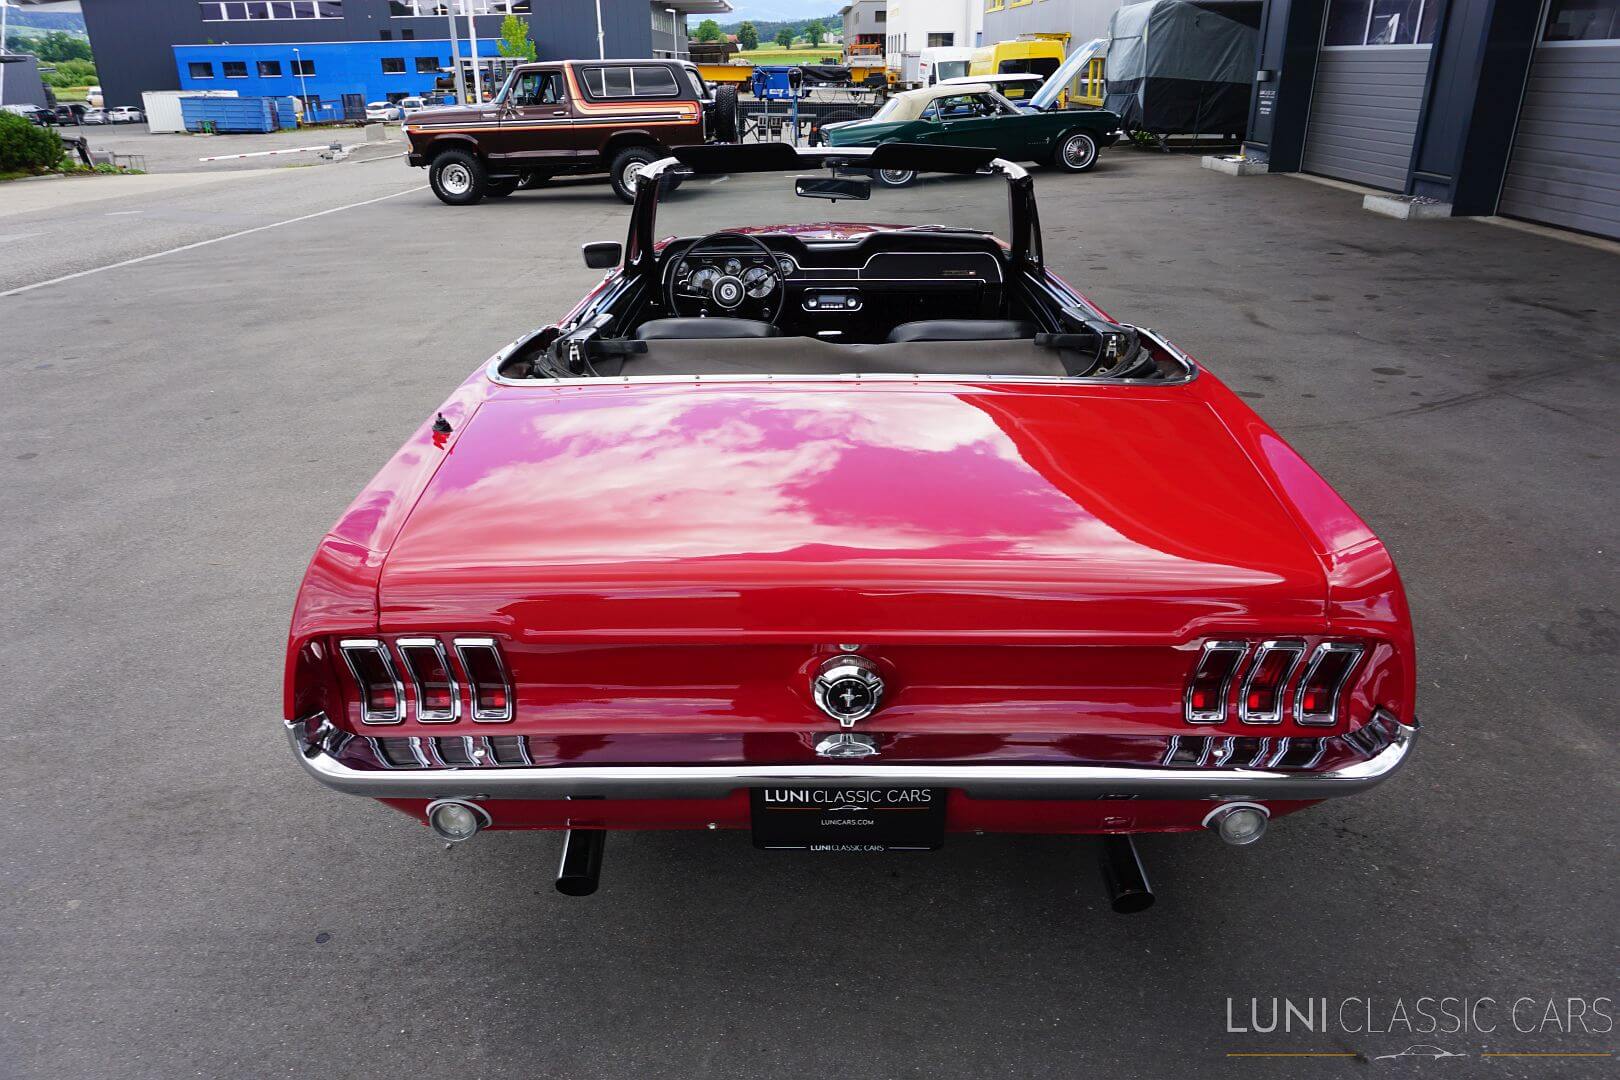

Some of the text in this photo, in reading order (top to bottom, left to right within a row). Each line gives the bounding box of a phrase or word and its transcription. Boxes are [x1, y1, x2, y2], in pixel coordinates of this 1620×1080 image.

[764, 789, 932, 803] LUNI CLASSIC CARS
[831, 844, 863, 852] CLASSIC
[863, 844, 885, 852] CARS
